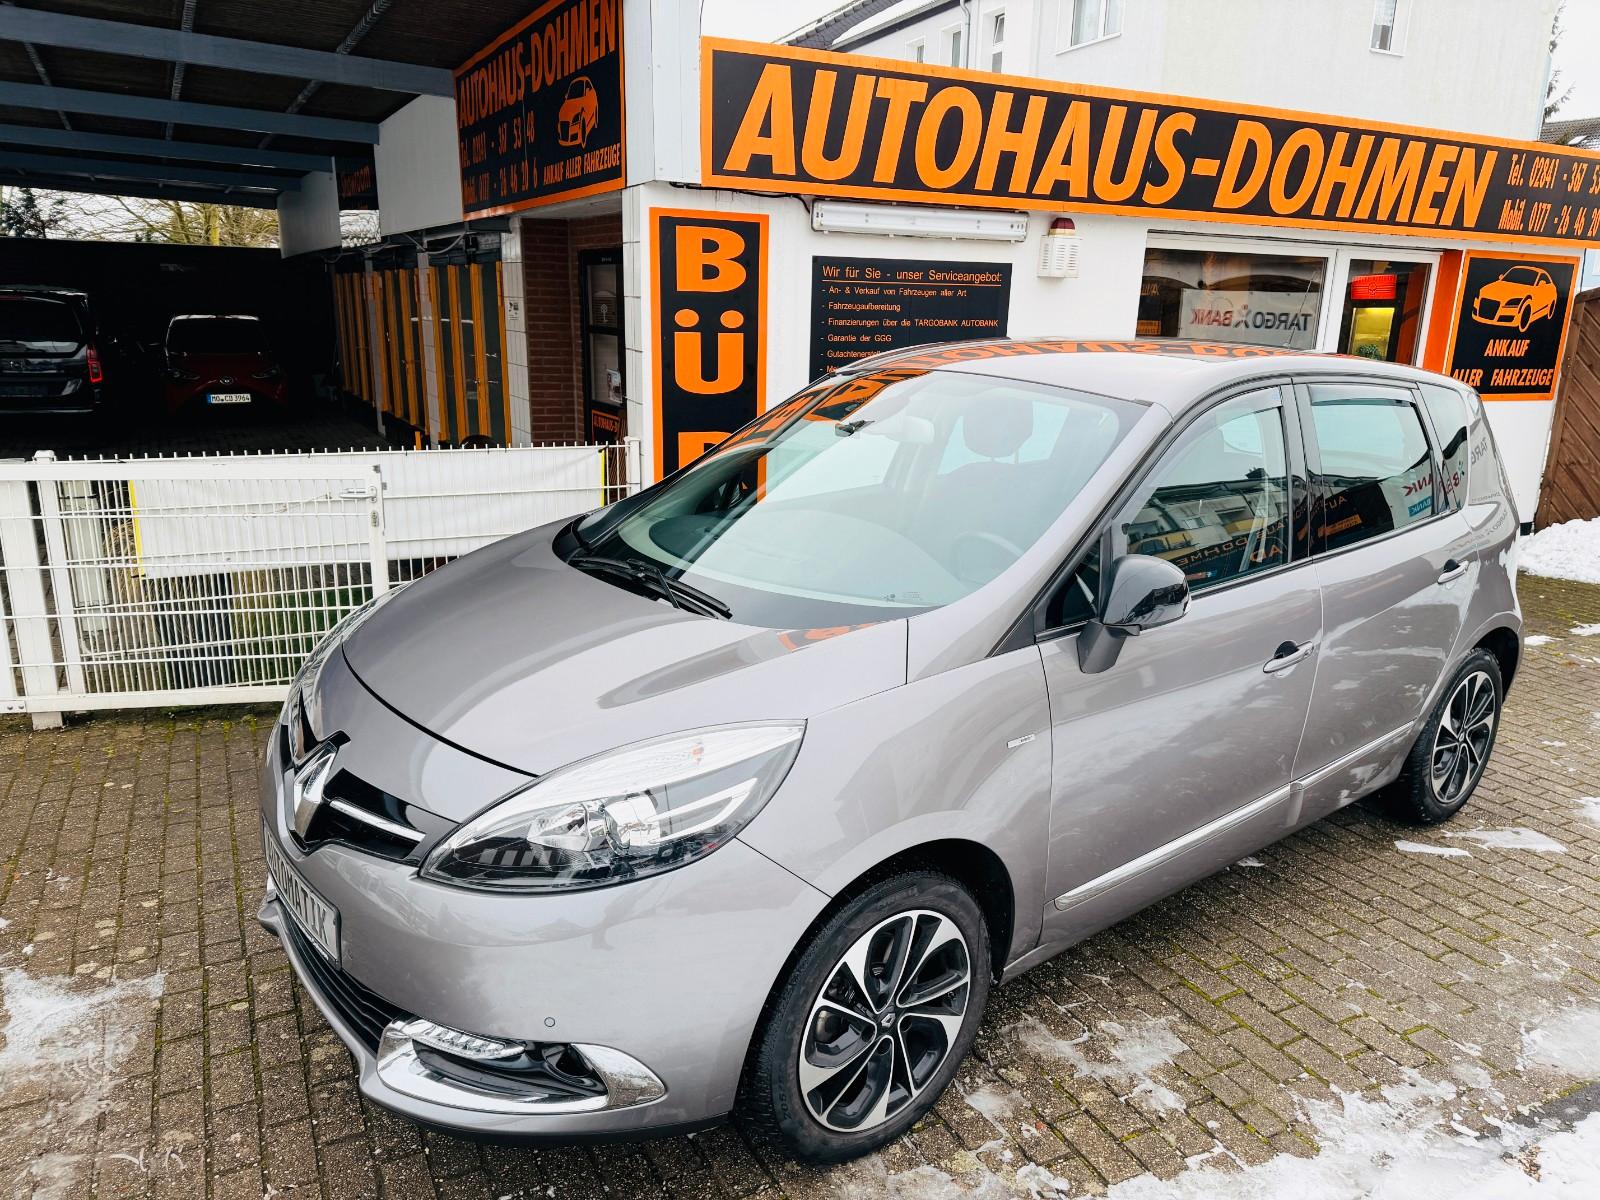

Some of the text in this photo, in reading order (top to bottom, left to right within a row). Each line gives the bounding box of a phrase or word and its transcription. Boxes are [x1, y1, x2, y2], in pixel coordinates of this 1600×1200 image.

[459, 0, 616, 128] AUTOHAUS-DOHMEN
[723, 62, 1498, 227] AUTOHAUS-DOHMEN
[543, 143, 620, 186] ANKAUF ALLER FAHRZEUGE
[1507, 153, 1526, 186] Tel.
[1529, 156, 1560, 189] 02841
[1568, 162, 1588, 192] 367
[1528, 202, 1552, 232] 0177
[1556, 205, 1572, 234] 26
[1574, 207, 1588, 236] 46
[822, 265, 840, 278] Wir
[845, 266, 860, 278] für
[865, 268, 880, 278] Sie
[896, 271, 924, 280] unser
[928, 269, 1002, 284] Serviceangebot:
[828, 286, 842, 294] An-
[844, 286, 850, 294] &
[898, 288, 936, 297] Fahrzeugen
[940, 288, 954, 296] aller
[828, 302, 900, 312] Fahrzeugaufbereitung
[828, 318, 880, 328] Finanzierungen
[882, 318, 898, 327] über
[900, 319, 911, 327] die
[914, 319, 958, 327] TARGOBANK
[960, 320, 998, 328] AUTOBANK
[828, 334, 856, 342] Garantie
[860, 334, 871, 342] der
[874, 334, 892, 342] GGG
[1484, 339, 1530, 357] ANKAUF
[1490, 369, 1554, 386] FAHRZEUGE
